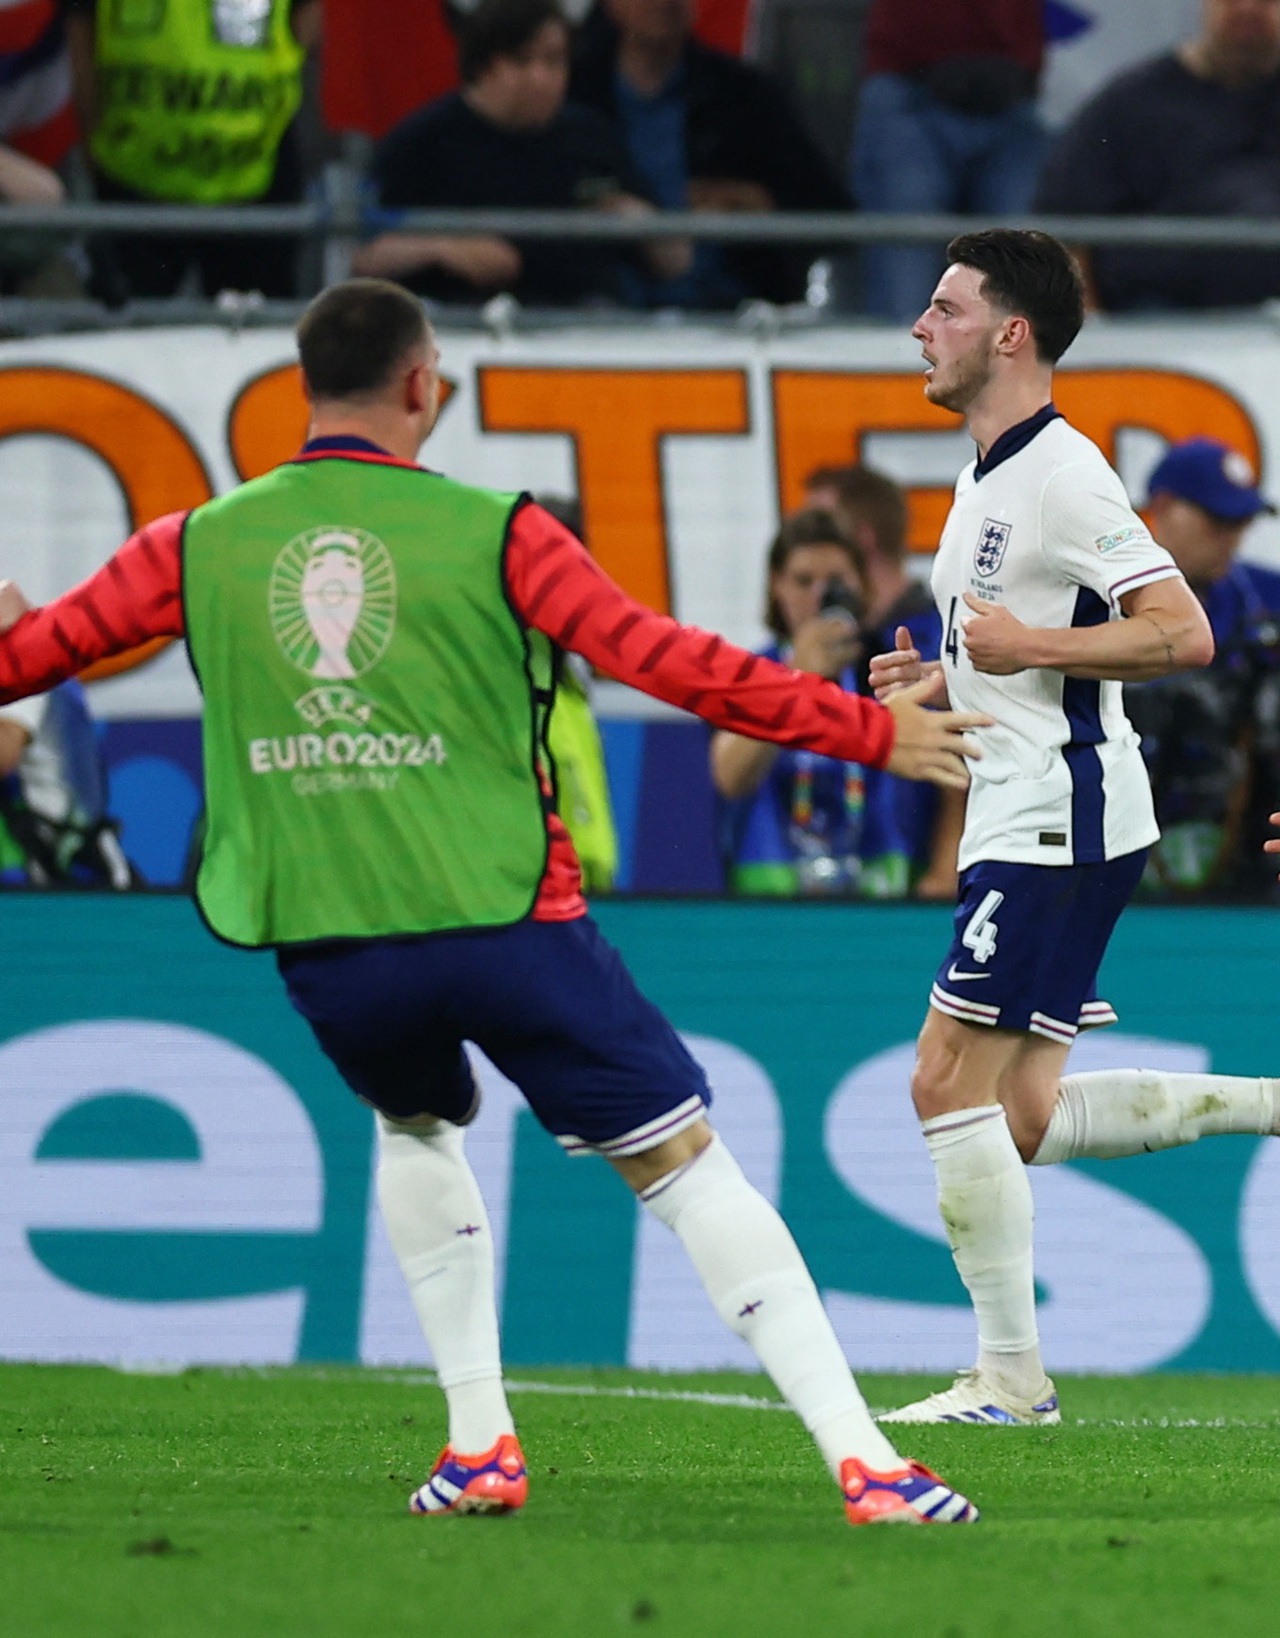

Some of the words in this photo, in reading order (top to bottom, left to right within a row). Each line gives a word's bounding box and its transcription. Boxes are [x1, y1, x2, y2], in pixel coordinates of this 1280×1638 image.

[945, 596, 959, 669] 4
[249, 732, 446, 774] EURO2024
[962, 889, 1004, 964] 4
